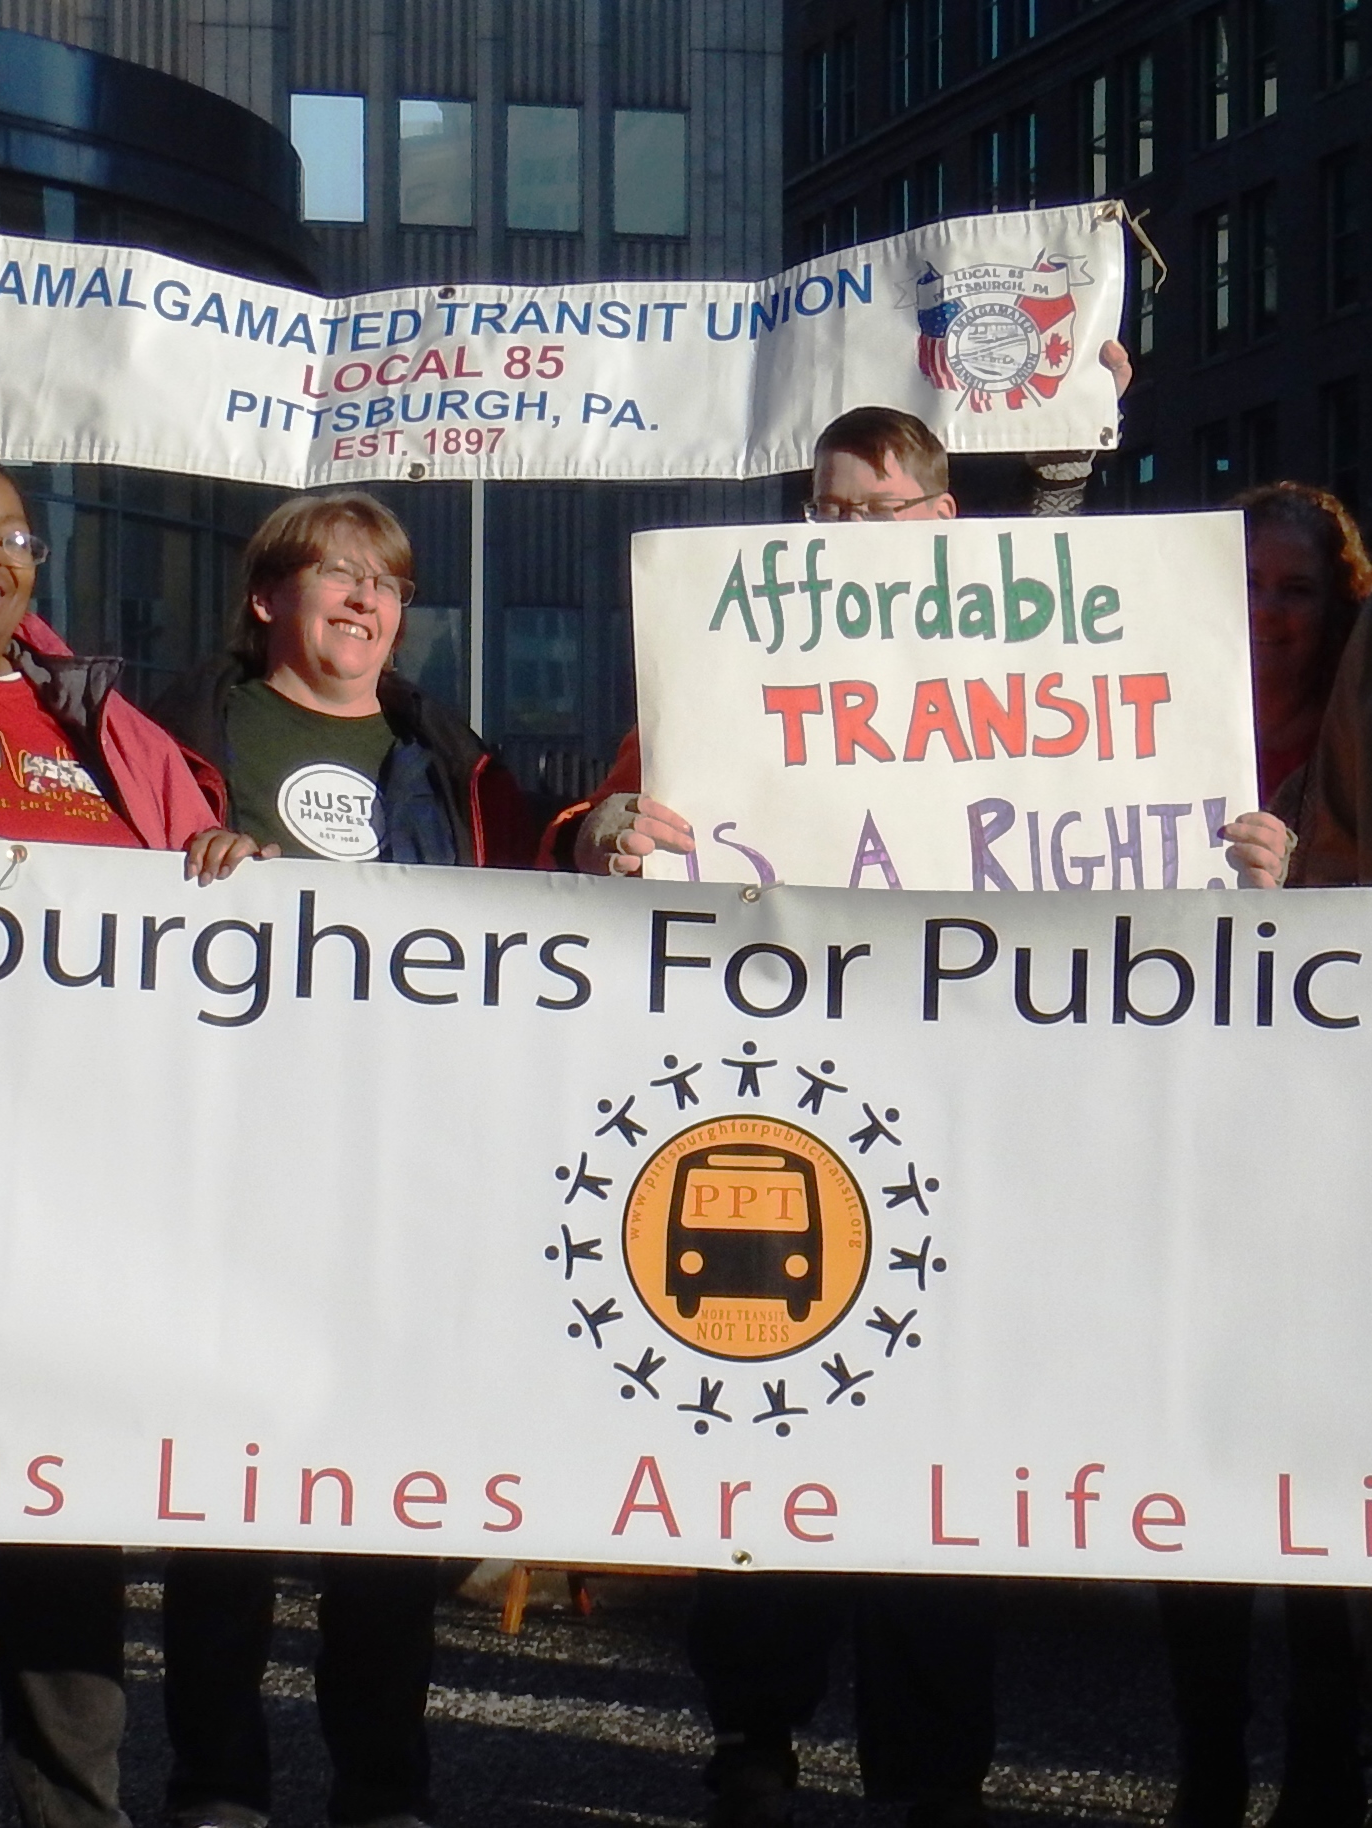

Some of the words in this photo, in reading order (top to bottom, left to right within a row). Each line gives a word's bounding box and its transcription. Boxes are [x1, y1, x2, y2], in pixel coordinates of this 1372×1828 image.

[953, 267, 1001, 282] LOCAL
[436, 301, 696, 343] TRANSIT
[706, 263, 874, 342] UNION
[302, 345, 484, 400] LOCAL
[503, 344, 566, 380] 85
[226, 388, 562, 440] PITTSBURGH,
[581, 393, 661, 432] PA.
[332, 429, 408, 461] EST.
[423, 427, 506, 456] 1897
[708, 531, 1124, 654] Affordable
[761, 672, 1172, 767] TRANSIT
[299, 789, 372, 816] JUST
[848, 808, 904, 890] A
[966, 797, 1227, 892] RIGHT!
[648, 909, 872, 1020] For
[920, 914, 1363, 1030] Public
[689, 1183, 804, 1222] PPT
[695, 1322, 738, 1342] NOT
[744, 1324, 791, 1343] LESS
[700, 1308, 731, 1321] MORE
[736, 1309, 786, 1323] TRANSIT
[157, 1437, 526, 1534] Lines
[610, 1455, 839, 1544] Are
[930, 1463, 1188, 1553] Life
